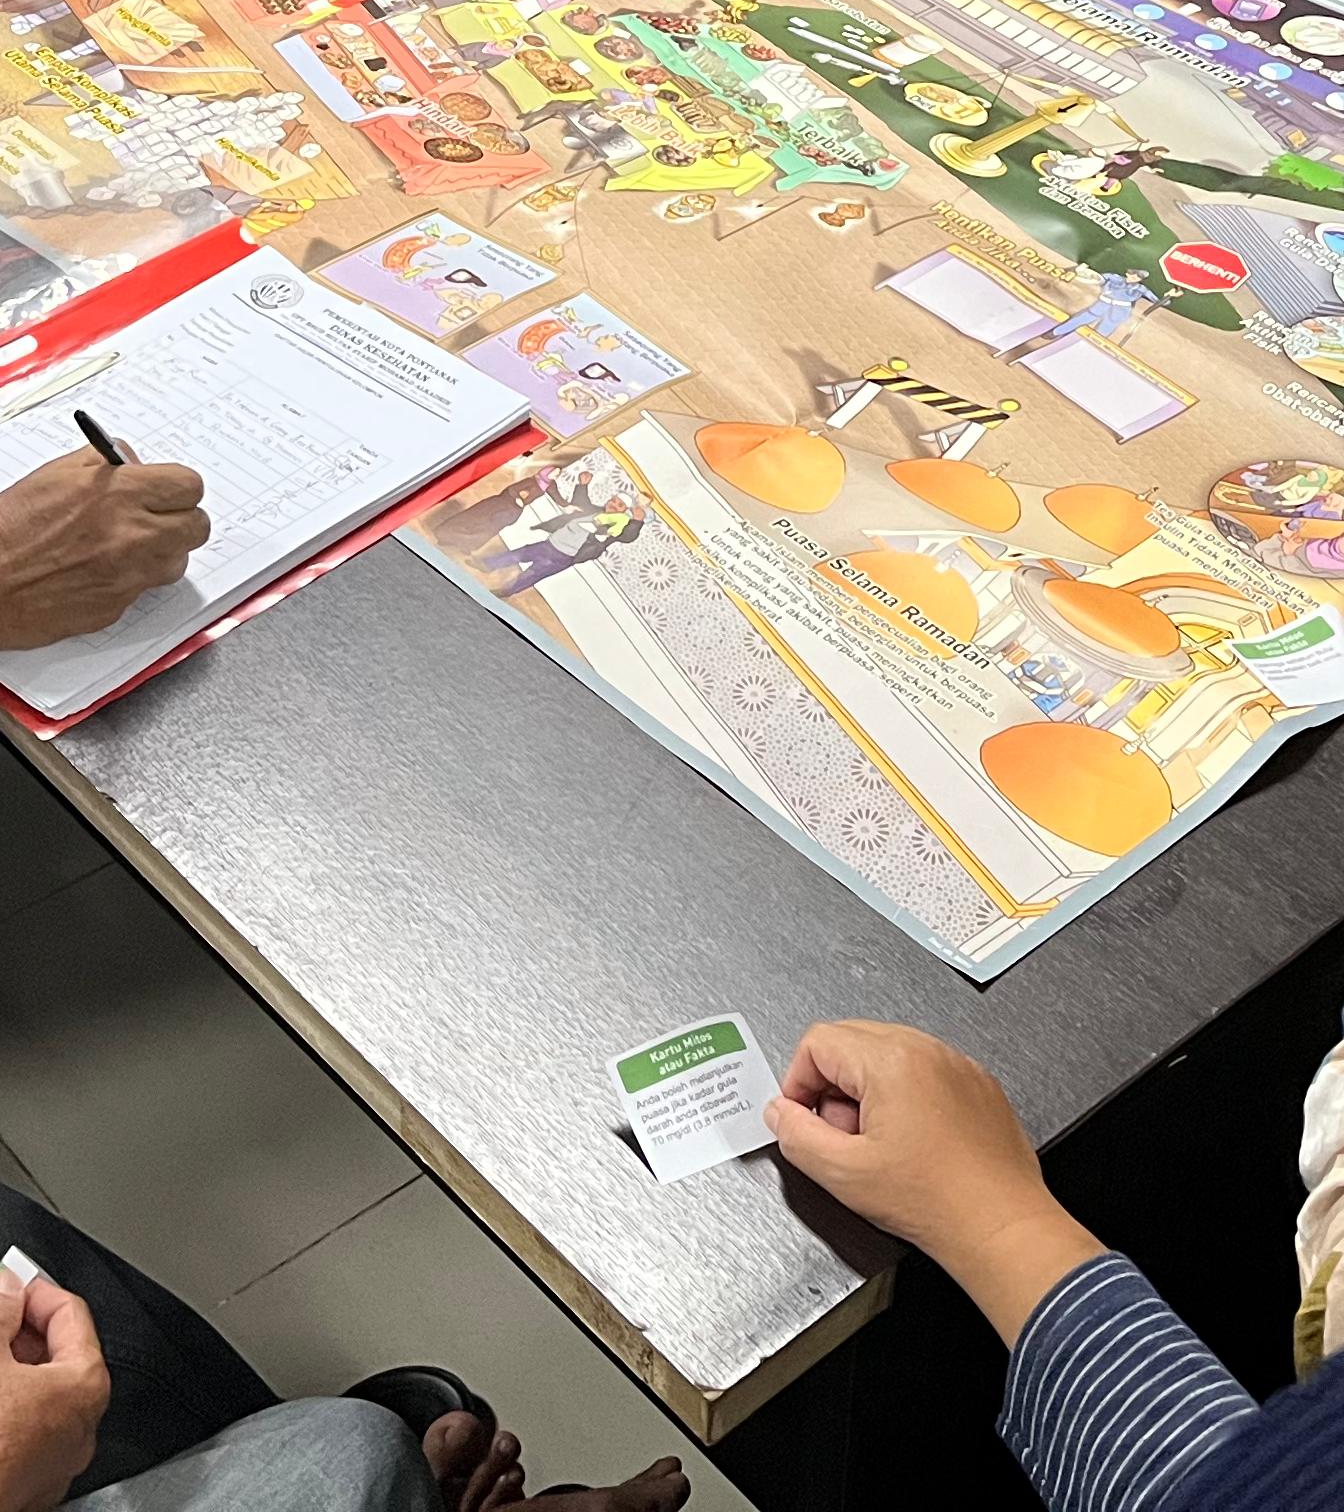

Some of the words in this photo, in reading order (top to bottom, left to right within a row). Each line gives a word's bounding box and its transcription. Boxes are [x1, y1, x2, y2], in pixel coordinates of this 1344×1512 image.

[35, 46, 74, 76] Empat
[73, 74, 138, 119] Komplikasi
[1136, 24, 1248, 89] Ramadan
[4, 50, 43, 79] Utama
[43, 76, 89, 110] Selama
[87, 105, 126, 135] Puasa
[411, 98, 473, 137] Hindari
[797, 121, 864, 168] Terbaik
[1039, 186, 1071, 206] dan
[1040, 174, 1110, 212] Aktivitas
[1107, 206, 1150, 239] Fisik
[931, 200, 1017, 252] Hentikan
[1016, 246, 1077, 283] Puasa
[934, 218, 979, 247] Anda
[1280, 238, 1314, 261] Gula
[1169, 250, 1241, 284] BERHENTI
[329, 324, 364, 346] DINAS
[363, 344, 431, 383] KESEHATAN
[1243, 333, 1282, 356] Fisik
[684, 550, 751, 600] hipoglikemia
[1153, 534, 1190, 558] puasa
[1192, 556, 1240, 587] menjadi
[1154, 502, 1173, 518] Tes
[1176, 515, 1202, 536] Gula
[1204, 534, 1240, 558] Darah
[1240, 556, 1265, 574] dan
[1266, 572, 1320, 609] Suntikan
[1187, 537, 1218, 560] Tidak
[1221, 559, 1305, 614] Menyebabkan
[738, 521, 775, 547] Agama
[776, 546, 805, 570] Islam
[806, 569, 854, 605] memberi
[854, 603, 929, 656] pengecualian
[930, 655, 958, 676] bagi
[958, 674, 993, 701] orang
[772, 518, 828, 559] Puasa
[829, 559, 898, 607] Selama
[900, 605, 991, 670] Ramadan
[697, 543, 727, 566] risiko
[728, 565, 787, 608] komplikasi
[786, 607, 823, 635] akibat
[878, 672, 924, 705] seperti
[710, 535, 741, 559] Untuk
[743, 560, 776, 584] orang
[774, 583, 803, 604] yang
[834, 626, 870, 653] puasa
[871, 651, 955, 710] meningkatkan
[723, 527, 752, 547] yang
[752, 546, 780, 567] sakit
[779, 564, 805, 586] atau
[807, 585, 848, 617] sedang
[905, 653, 937, 680] untuk
[940, 678, 996, 722] berpuasa.
[649, 1044, 683, 1065] Kartu
[682, 1030, 713, 1049] Mitos
[659, 1058, 684, 1076] atau
[685, 1044, 716, 1065] Fakta
[635, 1092, 661, 1109] Anda
[641, 1108, 670, 1123] puasa
[671, 1098, 688, 1114] jika
[689, 1085, 715, 1103] kadar
[716, 1076, 738, 1093] gula
[646, 1117, 673, 1136] darah
[675, 1108, 699, 1125] anda
